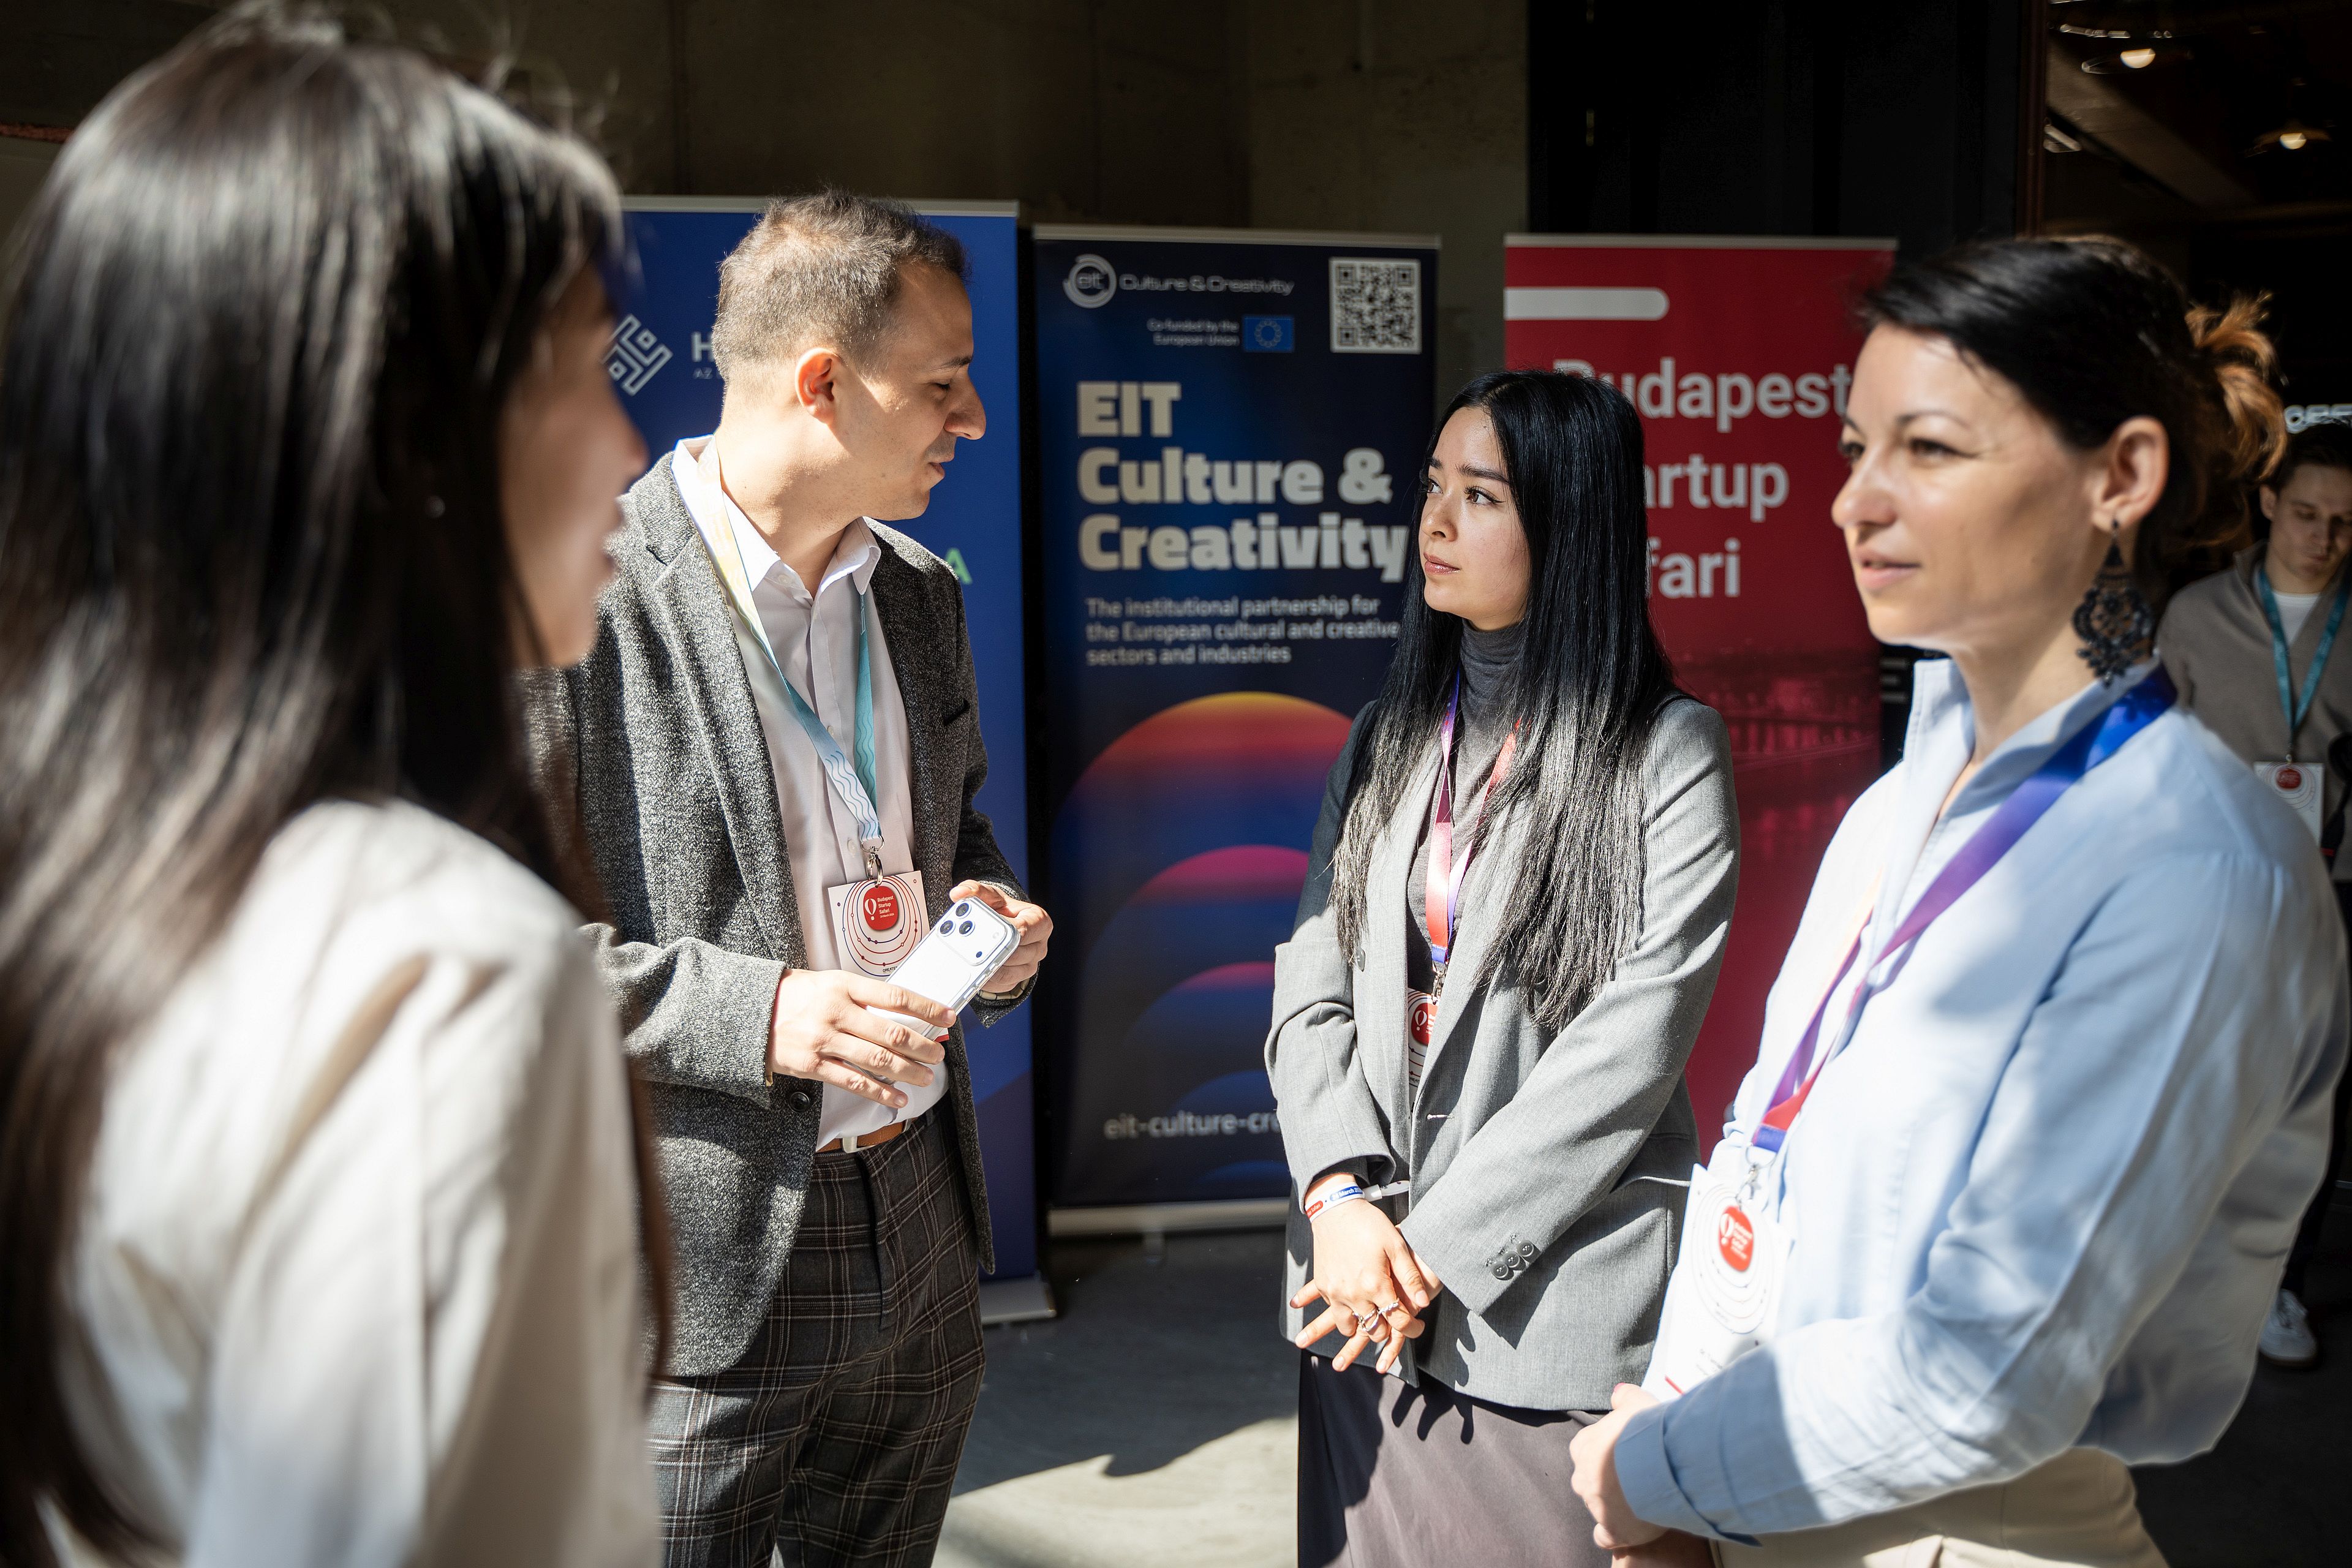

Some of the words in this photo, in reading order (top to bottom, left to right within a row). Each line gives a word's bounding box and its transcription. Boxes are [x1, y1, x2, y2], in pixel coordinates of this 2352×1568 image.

[1077, 382, 1182, 437] EIT
[1553, 356, 1852, 432] dapest
[1077, 447, 1324, 505] Culture
[1337, 447, 1393, 505] &
[1644, 454, 1790, 523] rtup
[1078, 513, 1407, 582] Creativity
[1645, 536, 1741, 598] fari
[1085, 597, 1122, 618] The
[1125, 595, 1238, 617] institutional
[1241, 594, 1349, 620] partnership
[1351, 594, 1381, 615] for
[1085, 621, 1120, 642] the
[1121, 621, 1212, 646] European
[1213, 619, 1286, 641] cultural
[1287, 618, 1324, 639] and
[1325, 617, 1400, 639] creative
[1085, 646, 1157, 666] sectors
[1159, 644, 1196, 665] and
[1197, 643, 1291, 663] industries
